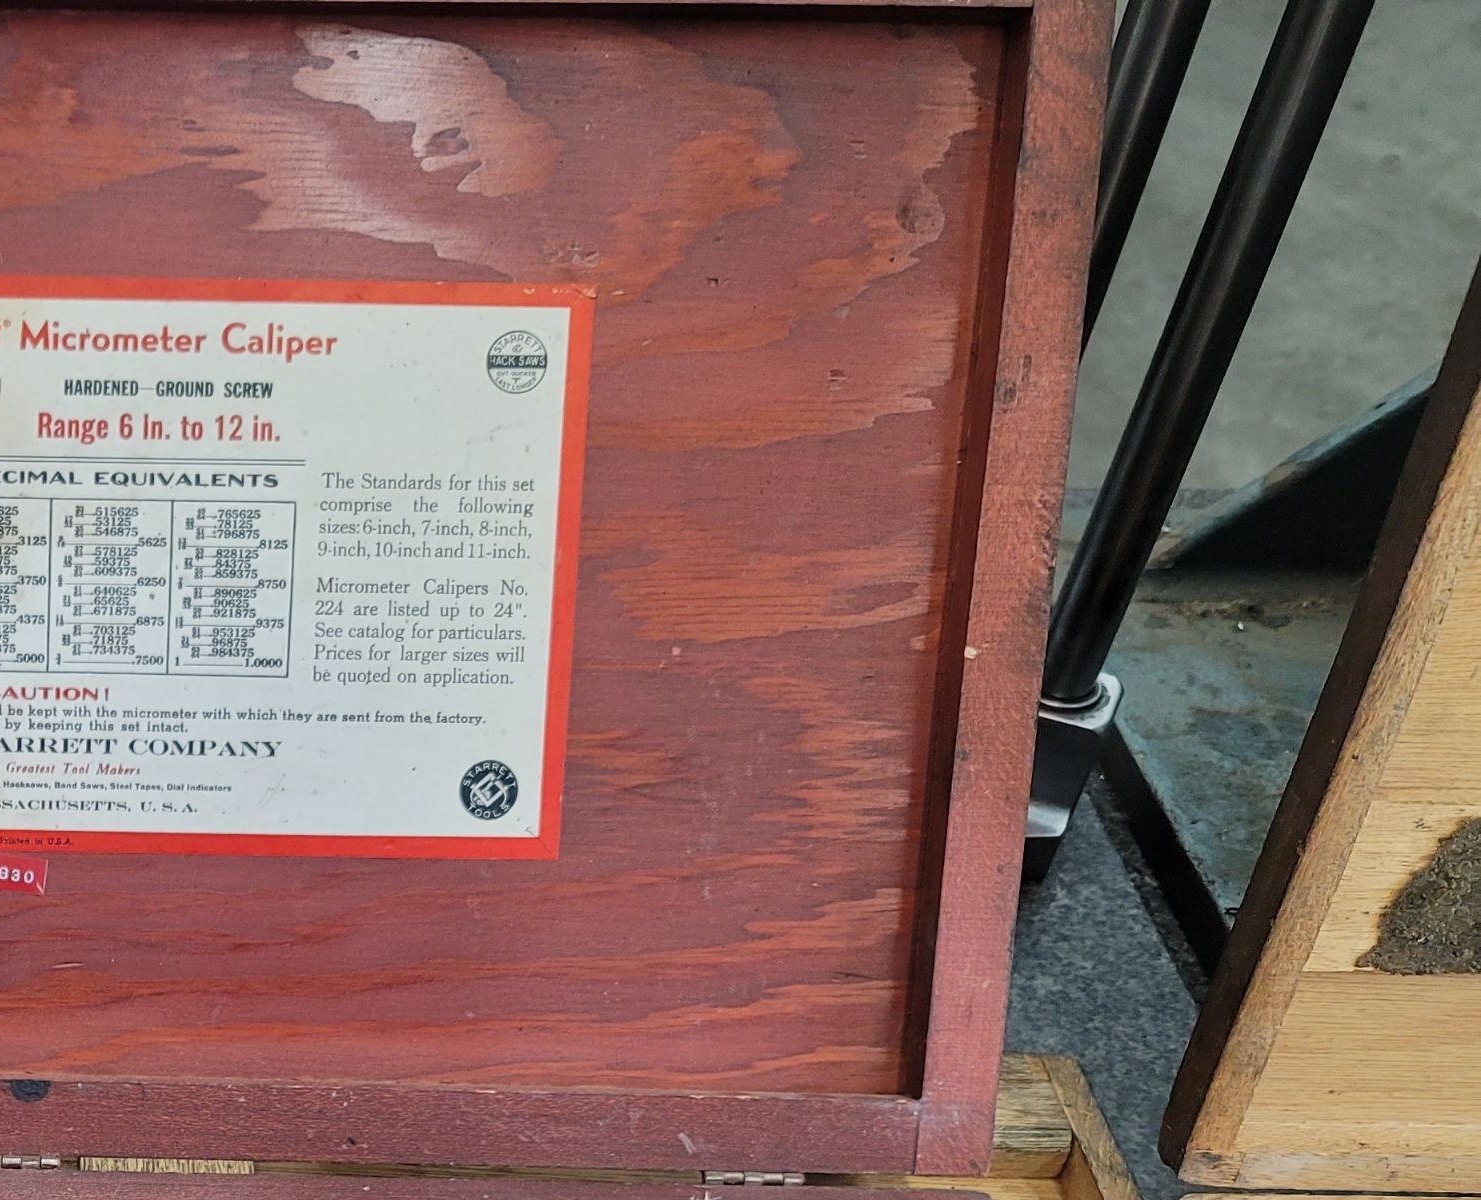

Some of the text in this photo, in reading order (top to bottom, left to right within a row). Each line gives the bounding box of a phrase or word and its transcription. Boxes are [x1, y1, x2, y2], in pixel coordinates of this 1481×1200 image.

[20, 319, 207, 353] Micrometer
[221, 322, 338, 363] Caliper
[493, 333, 542, 354] STARRETT
[518, 355, 546, 367] SAWS
[223, 381, 273, 399] SCREW
[38, 412, 280, 445] Range 6 to 12 in.
[94, 471, 279, 488] EQUIVALENTS
[321, 472, 535, 492] The Standards for this set
[320, 496, 534, 518] comprise the following
[319, 518, 532, 539] sizes: 6-inch, 7-inch, 8-inch,
[318, 540, 530, 560] 9-inch, 10-inch and 11-inch.
[316, 577, 528, 599] Micrometer Calipers No.
[315, 600, 344, 616] 224
[353, 605, 378, 616] are
[388, 599, 430, 617] listed
[440, 602, 460, 621] up
[469, 604, 484, 617] to
[313, 665, 514, 687] be quoted on application.
[7, 704, 24, 716] be
[28, 704, 57, 719] kept
[62, 705, 91, 718] with
[96, 705, 117, 718] the
[122, 707, 197, 719] micrometer
[202, 707, 231, 720] with
[236, 708, 277, 720] which
[280, 709, 312, 723] they
[316, 714, 337, 722] are
[342, 712, 370, 722] sent
[374, 710, 405, 723] from
[410, 711, 433, 724] the
[436, 711, 486, 726] factory.
[128, 739, 282, 757] COMPANY
[6, 762, 55, 774] Greatest
[63, 762, 90, 774] Tool
[96, 763, 140, 775] Makers
[463, 762, 517, 788] STARRETT
[54, 781, 77, 789] Band
[80, 782, 107, 791] Saws,
[110, 782, 132, 790] Steel
[135, 783, 164, 792] Tapes,
[166, 783, 184, 791] Dial
[187, 784, 231, 792] Indicators
[140, 801, 156, 812] U.
[162, 802, 177, 813] S.
[468, 802, 511, 819] TOOLS
